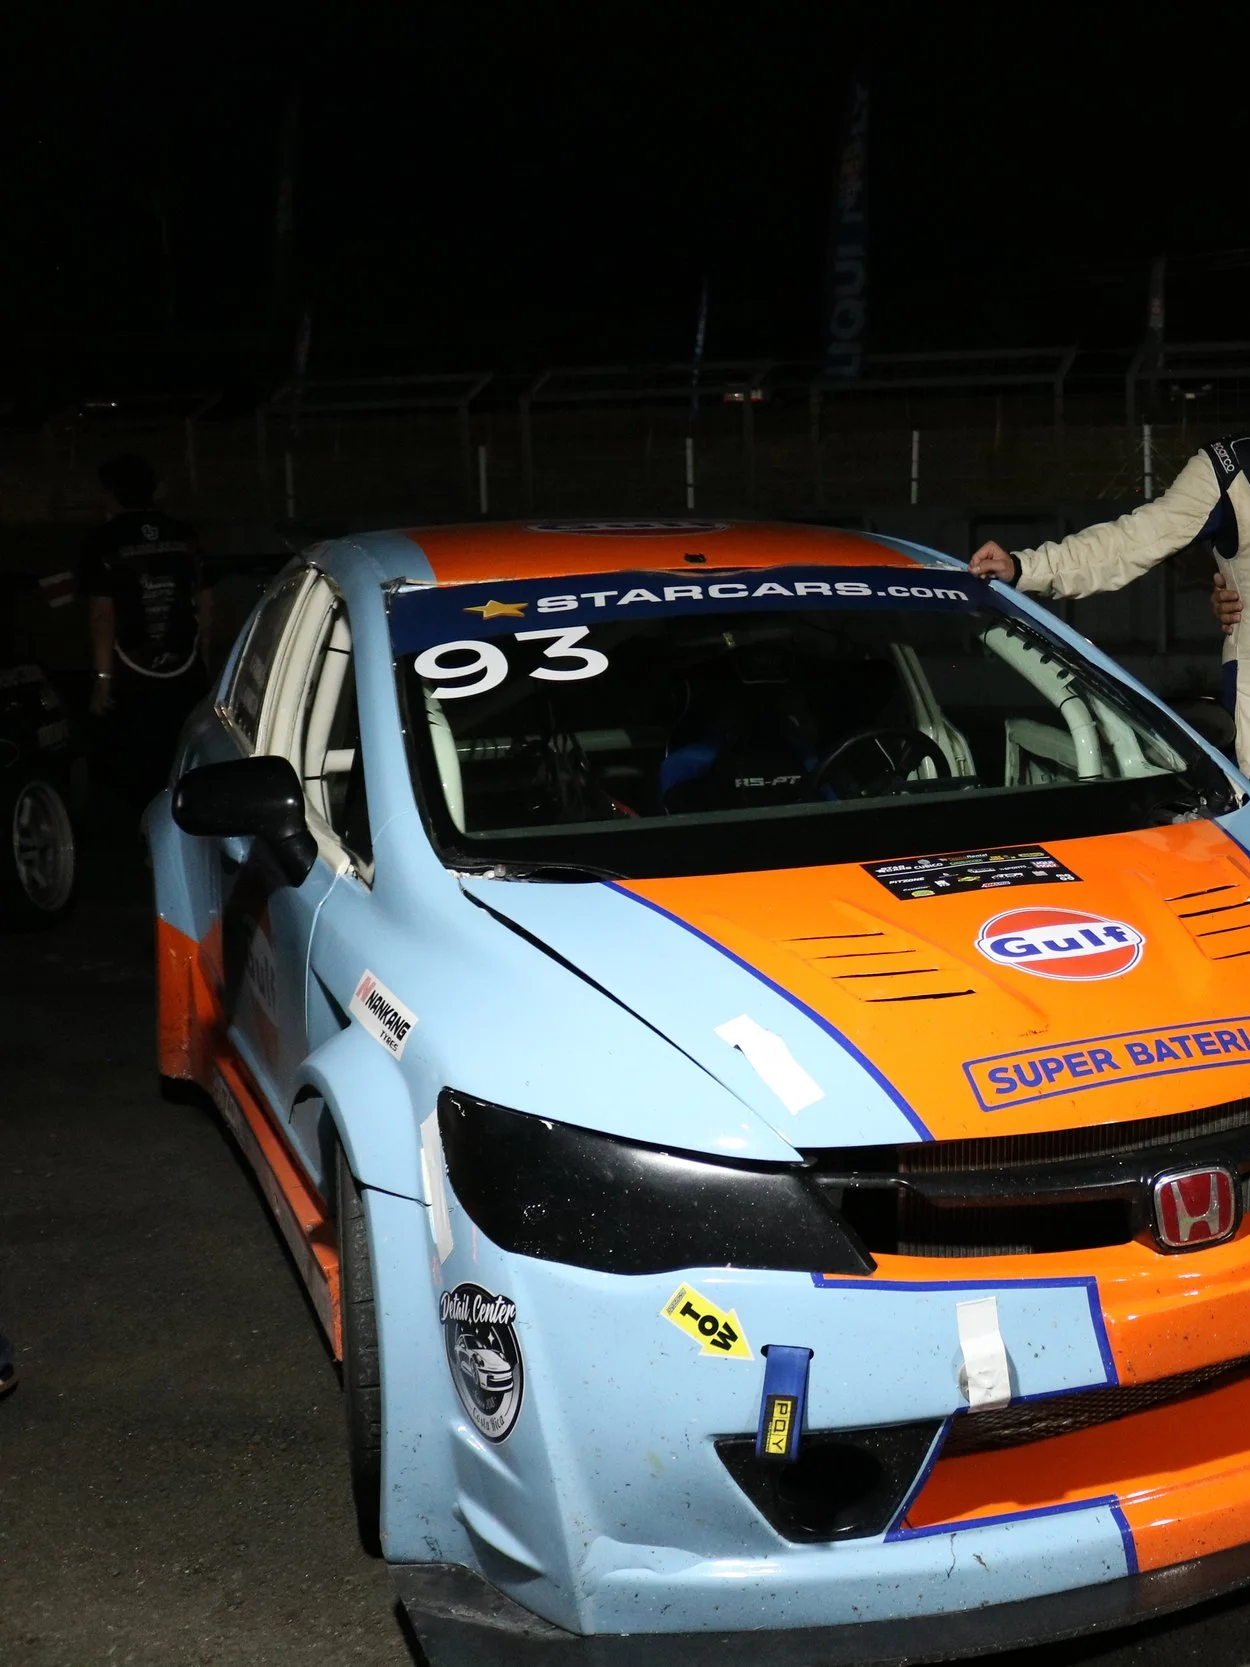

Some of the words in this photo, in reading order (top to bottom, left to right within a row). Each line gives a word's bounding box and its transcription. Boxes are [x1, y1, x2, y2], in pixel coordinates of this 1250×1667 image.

[537, 581, 969, 613] STARCARS.com
[414, 626, 609, 700] 93
[990, 925, 1130, 958] Gulf
[364, 989, 411, 1041] NANKANG
[380, 1030, 399, 1052] TYRES
[988, 1048, 1121, 1095] SUPER
[440, 1291, 470, 1322] Detail
[472, 1293, 517, 1325] Center
[680, 1301, 739, 1352] TOW
[472, 1407, 491, 1431] Costa
[491, 1414, 505, 1432] Rica
